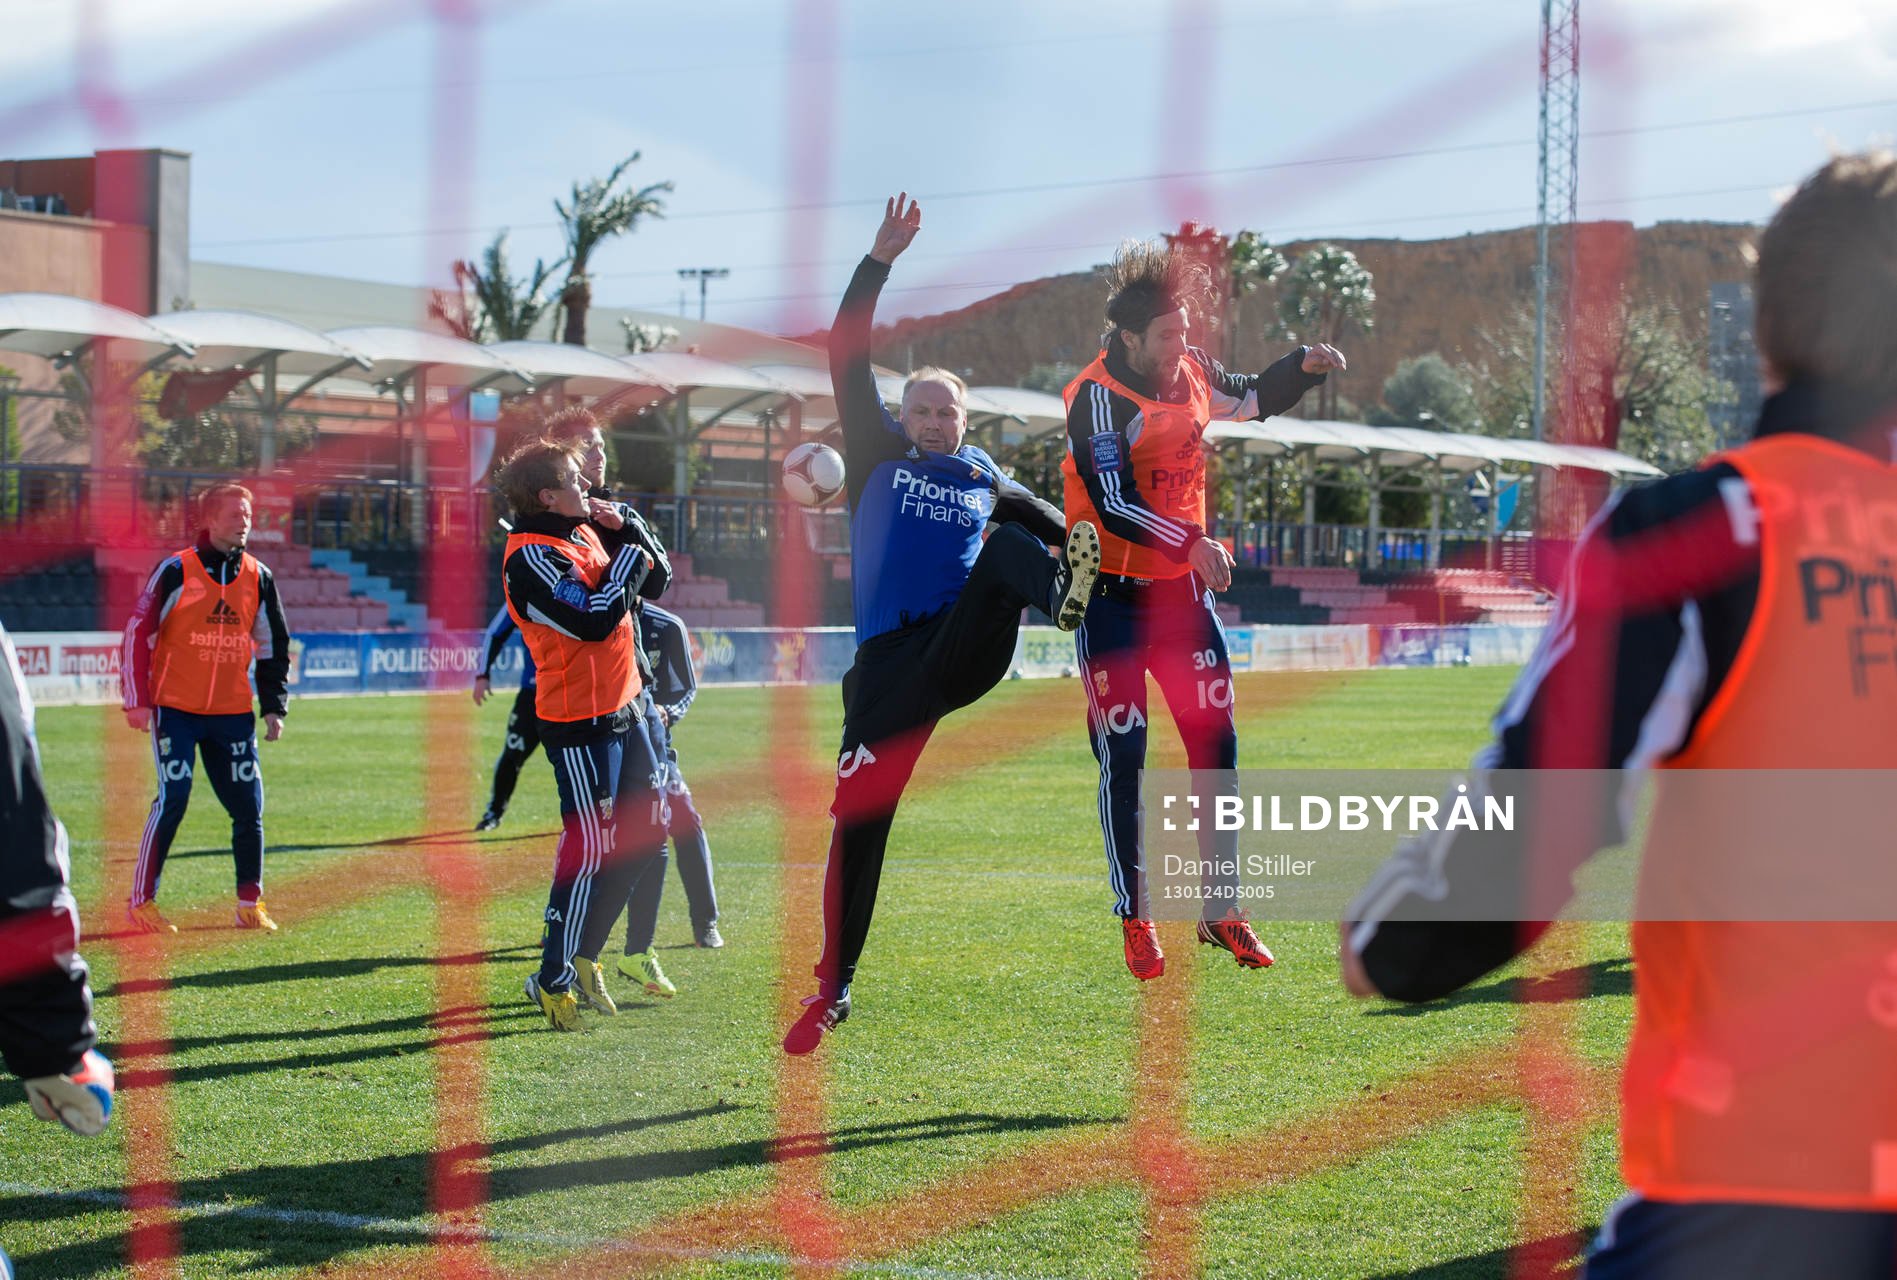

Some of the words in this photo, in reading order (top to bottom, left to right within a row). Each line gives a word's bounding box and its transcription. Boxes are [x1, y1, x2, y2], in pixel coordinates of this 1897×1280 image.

[1152, 467, 1204, 490] Prio
[892, 468, 983, 515] Prioritet
[901, 493, 972, 527] Finans
[1193, 649, 1217, 670] 30
[1100, 702, 1146, 736] ICA
[231, 741, 247, 756] 17
[507, 733, 525, 751] CA
[160, 760, 192, 783] ICA
[838, 743, 877, 778] CA
